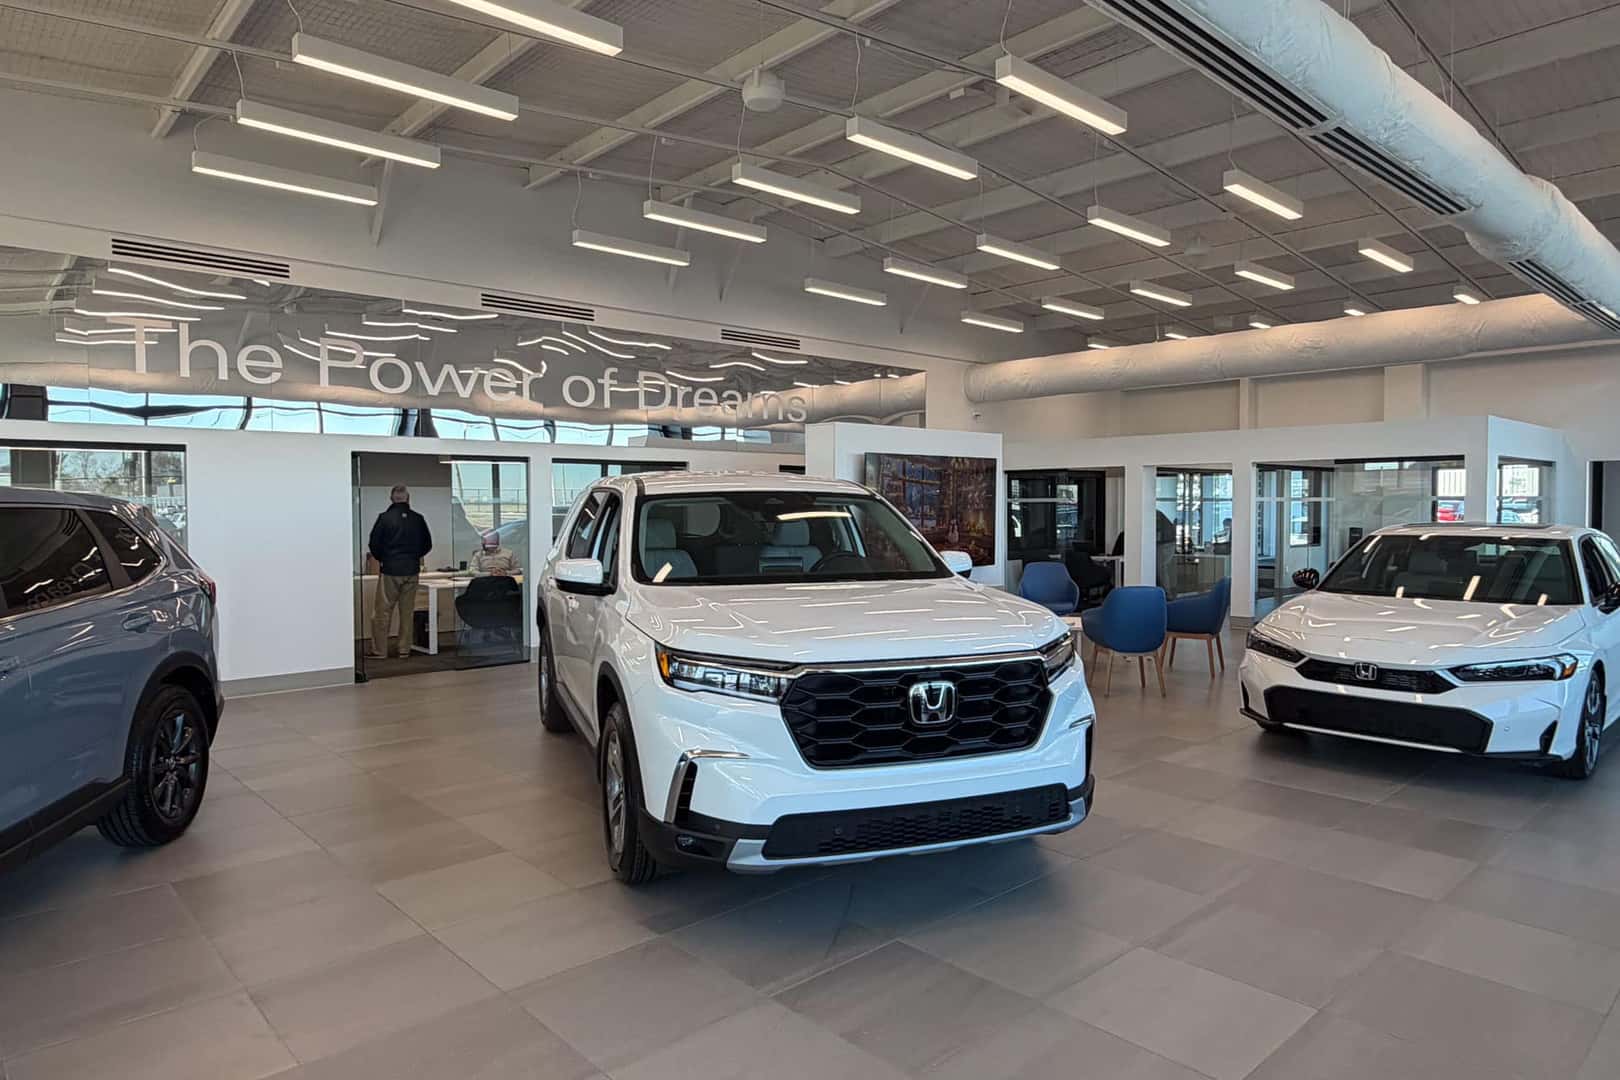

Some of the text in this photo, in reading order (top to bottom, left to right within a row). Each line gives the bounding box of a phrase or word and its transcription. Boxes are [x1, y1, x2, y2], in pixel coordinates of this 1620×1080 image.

[106, 316, 807, 422] The Power of Dreams
